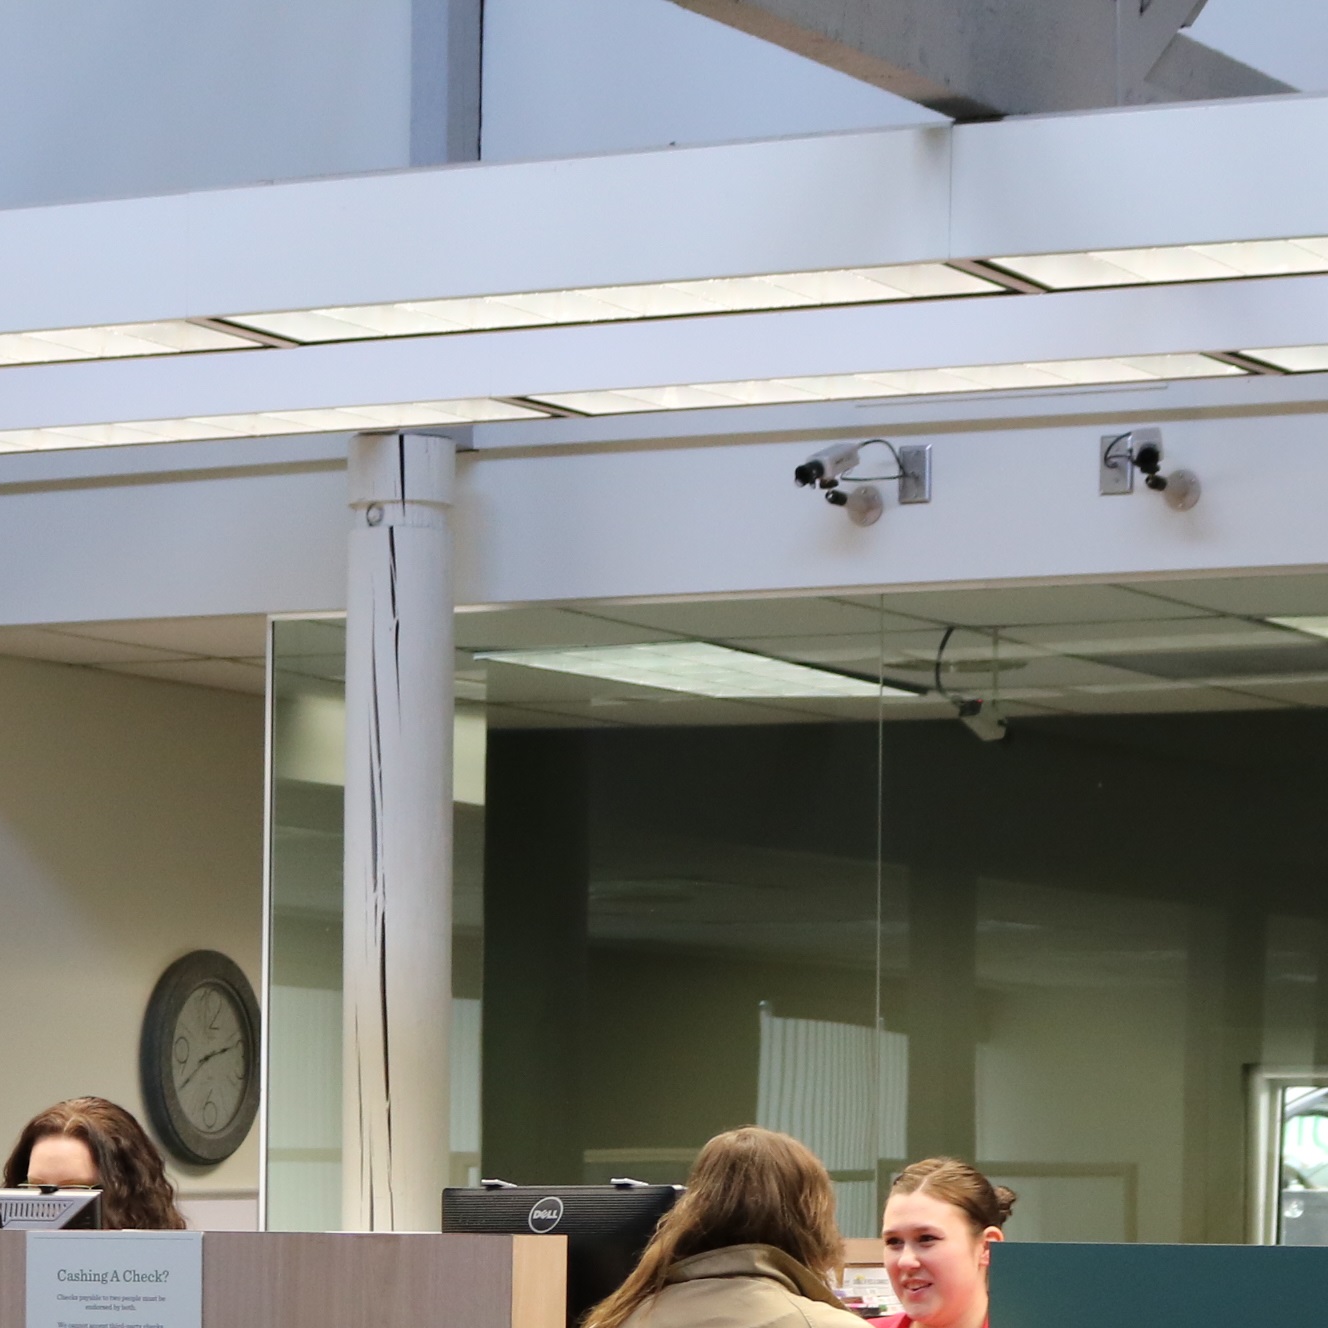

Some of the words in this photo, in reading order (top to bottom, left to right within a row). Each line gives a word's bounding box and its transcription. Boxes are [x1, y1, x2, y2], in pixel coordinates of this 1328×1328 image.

[533, 1209, 557, 1219] DELL
[57, 1269, 109, 1285] Cashing
[110, 1269, 121, 1282] A
[122, 1269, 170, 1283] Check?
